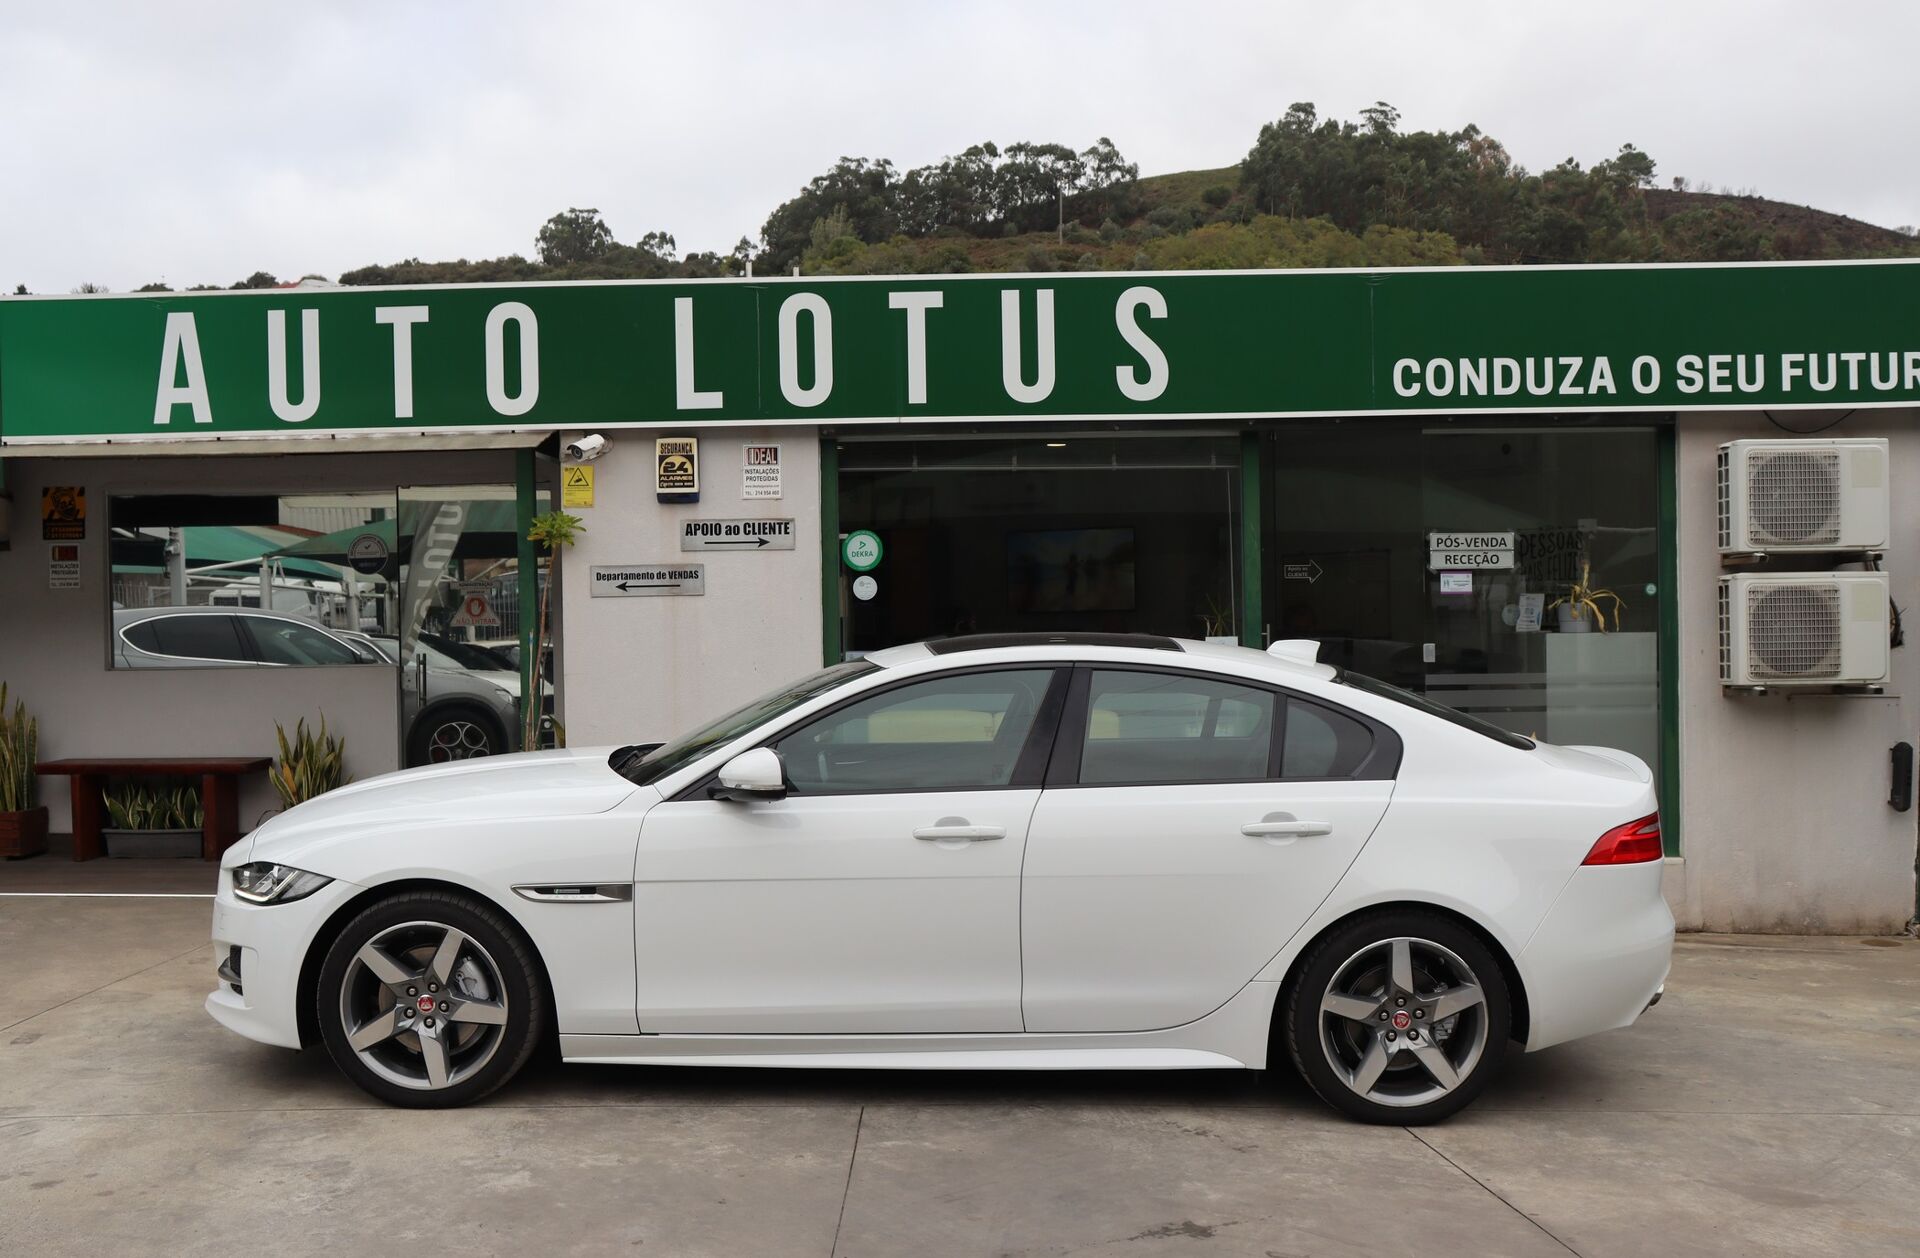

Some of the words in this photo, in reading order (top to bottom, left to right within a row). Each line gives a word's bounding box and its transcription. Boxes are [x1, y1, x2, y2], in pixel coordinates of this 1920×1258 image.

[153, 301, 541, 425] AUTO
[674, 285, 1170, 410] LOTUS
[1392, 355, 1617, 398] CONDUZA
[1631, 354, 1661, 394] O
[1676, 353, 1765, 393] SEU
[750, 448, 777, 465] IDEAL
[663, 461, 689, 474] 24
[744, 467, 780, 475] INSTALAÇÕES
[685, 522, 722, 536] APOIO
[724, 524, 741, 536] ao
[743, 521, 790, 536] CLIENTE
[1436, 535, 1507, 548] PÓS-VENDA
[1519, 532, 1583, 559] PESSOAS
[851, 550, 874, 558] DEKRA
[1445, 551, 1500, 567] RECEÇÃO
[596, 571, 655, 582] Departamento
[656, 571, 667, 580] de
[668, 570, 699, 580] VENDAS
